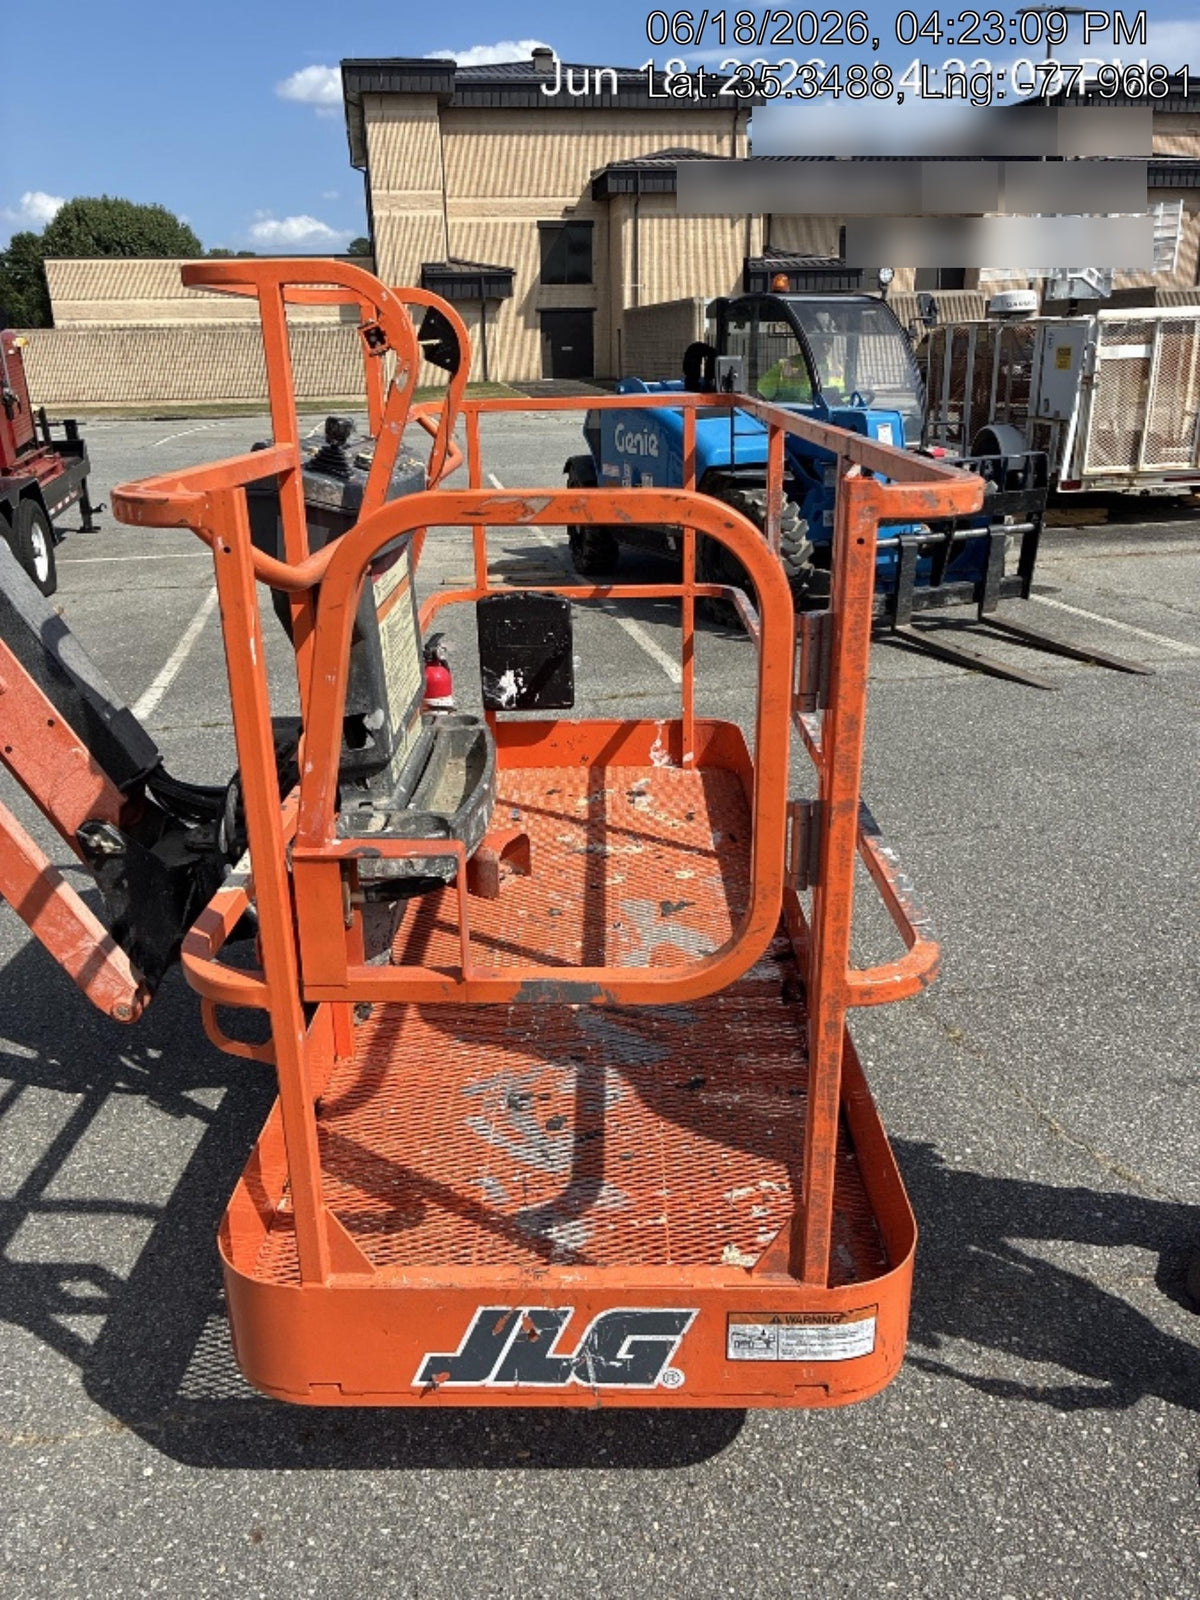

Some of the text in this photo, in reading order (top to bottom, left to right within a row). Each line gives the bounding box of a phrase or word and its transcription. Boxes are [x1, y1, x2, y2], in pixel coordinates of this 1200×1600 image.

[615, 423, 659, 457] Genie
[785, 1314, 842, 1326] WARNING
[410, 1305, 701, 1389] JLG
